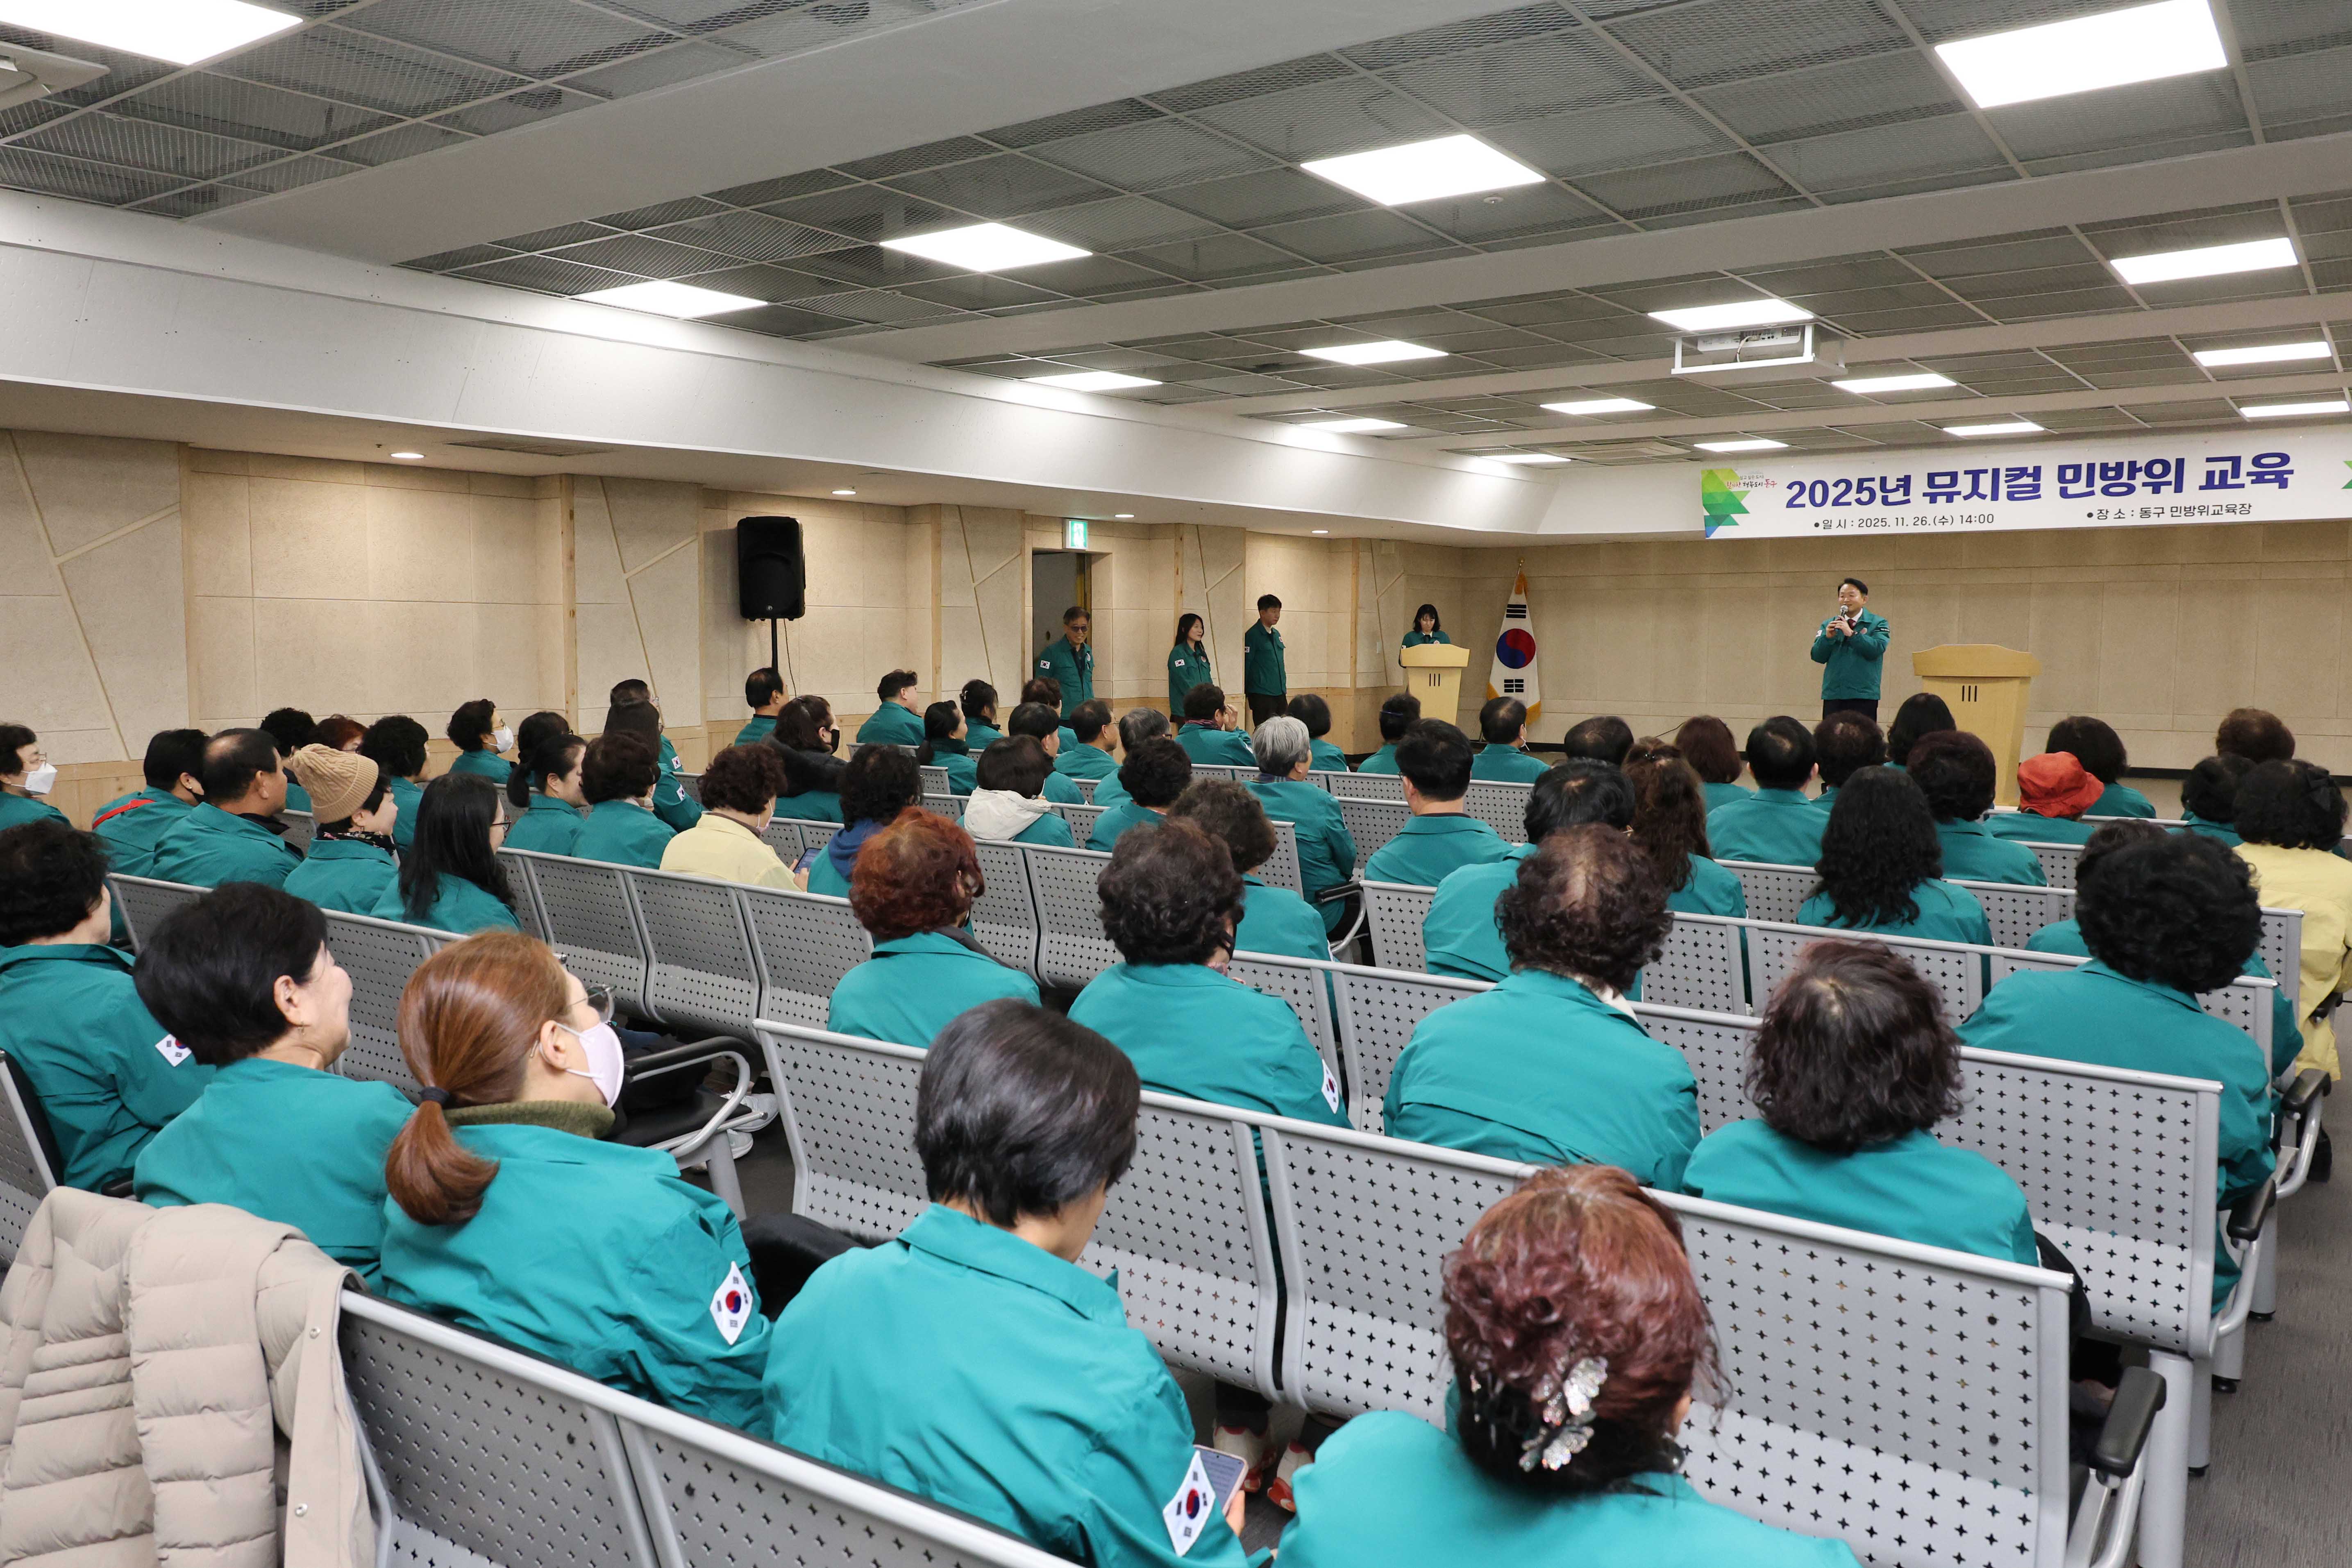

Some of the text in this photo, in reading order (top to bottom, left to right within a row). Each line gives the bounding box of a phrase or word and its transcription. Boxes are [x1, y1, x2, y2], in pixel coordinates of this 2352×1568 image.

[1764, 479, 1778, 488] 동구
[1786, 452, 2294, 508] 2025년 뮤지컬 민방위 교육
[2139, 507, 2165, 519] 동구
[2170, 503, 2252, 517] 민방위교육장
[1858, 518, 1890, 528] 2025.
[1895, 517, 1908, 526] 11.
[1960, 514, 1994, 524] 14:00
